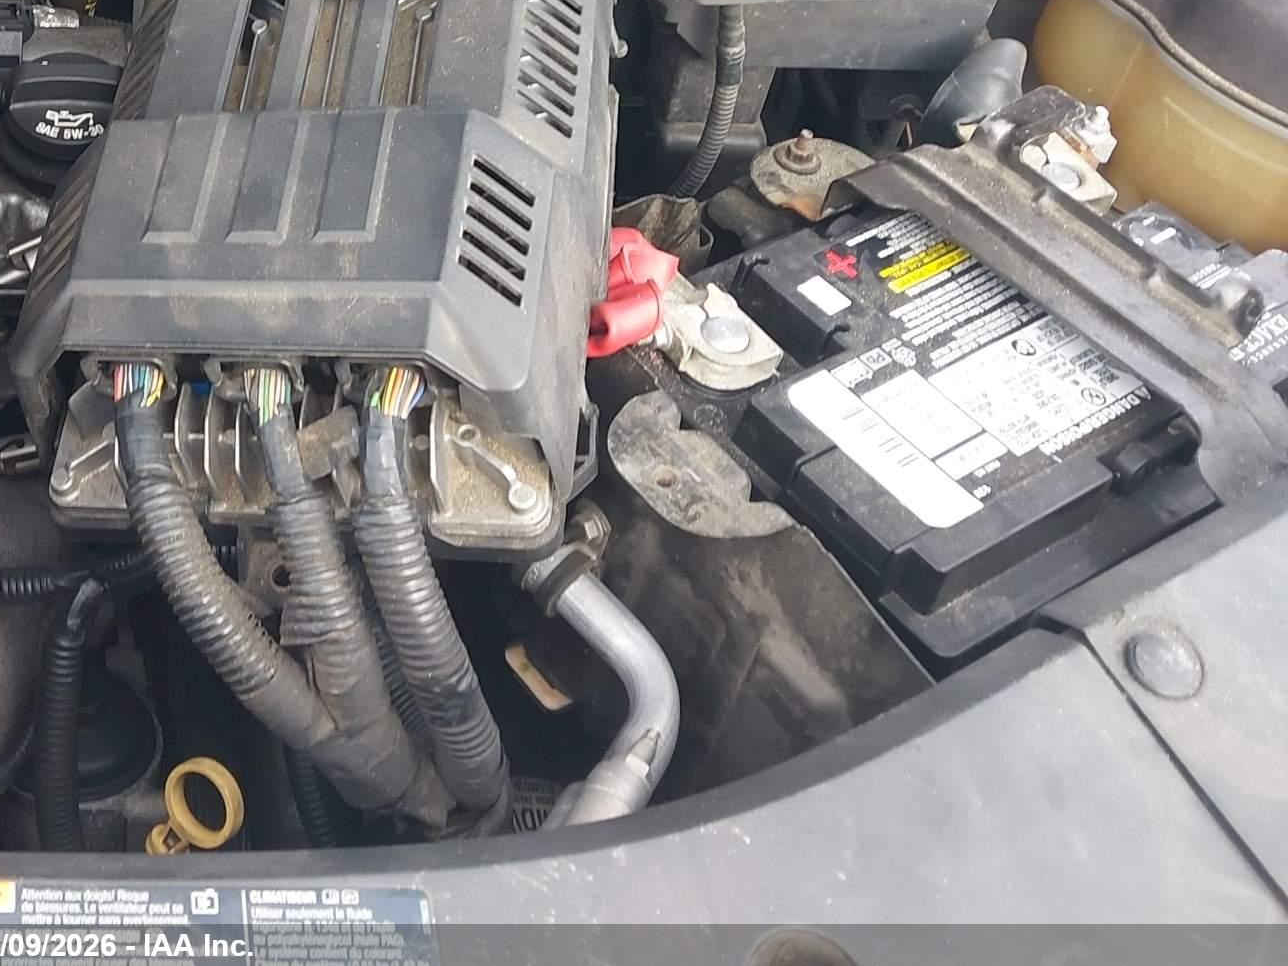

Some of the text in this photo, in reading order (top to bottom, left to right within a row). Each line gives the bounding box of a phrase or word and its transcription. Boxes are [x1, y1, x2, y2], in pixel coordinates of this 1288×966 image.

[35, 121, 60, 139] SAE
[21, 888, 149, 903] Attention aux doigts! Risque
[250, 890, 317, 904] CLIMATISEUR
[21, 901, 33, 914] de
[97, 902, 148, 915] ventilateur
[148, 903, 171, 916] peut
[171, 904, 185, 915] se
[285, 907, 335, 920] seulement
[21, 914, 53, 926] mettre
[62, 914, 97, 926] tourner
